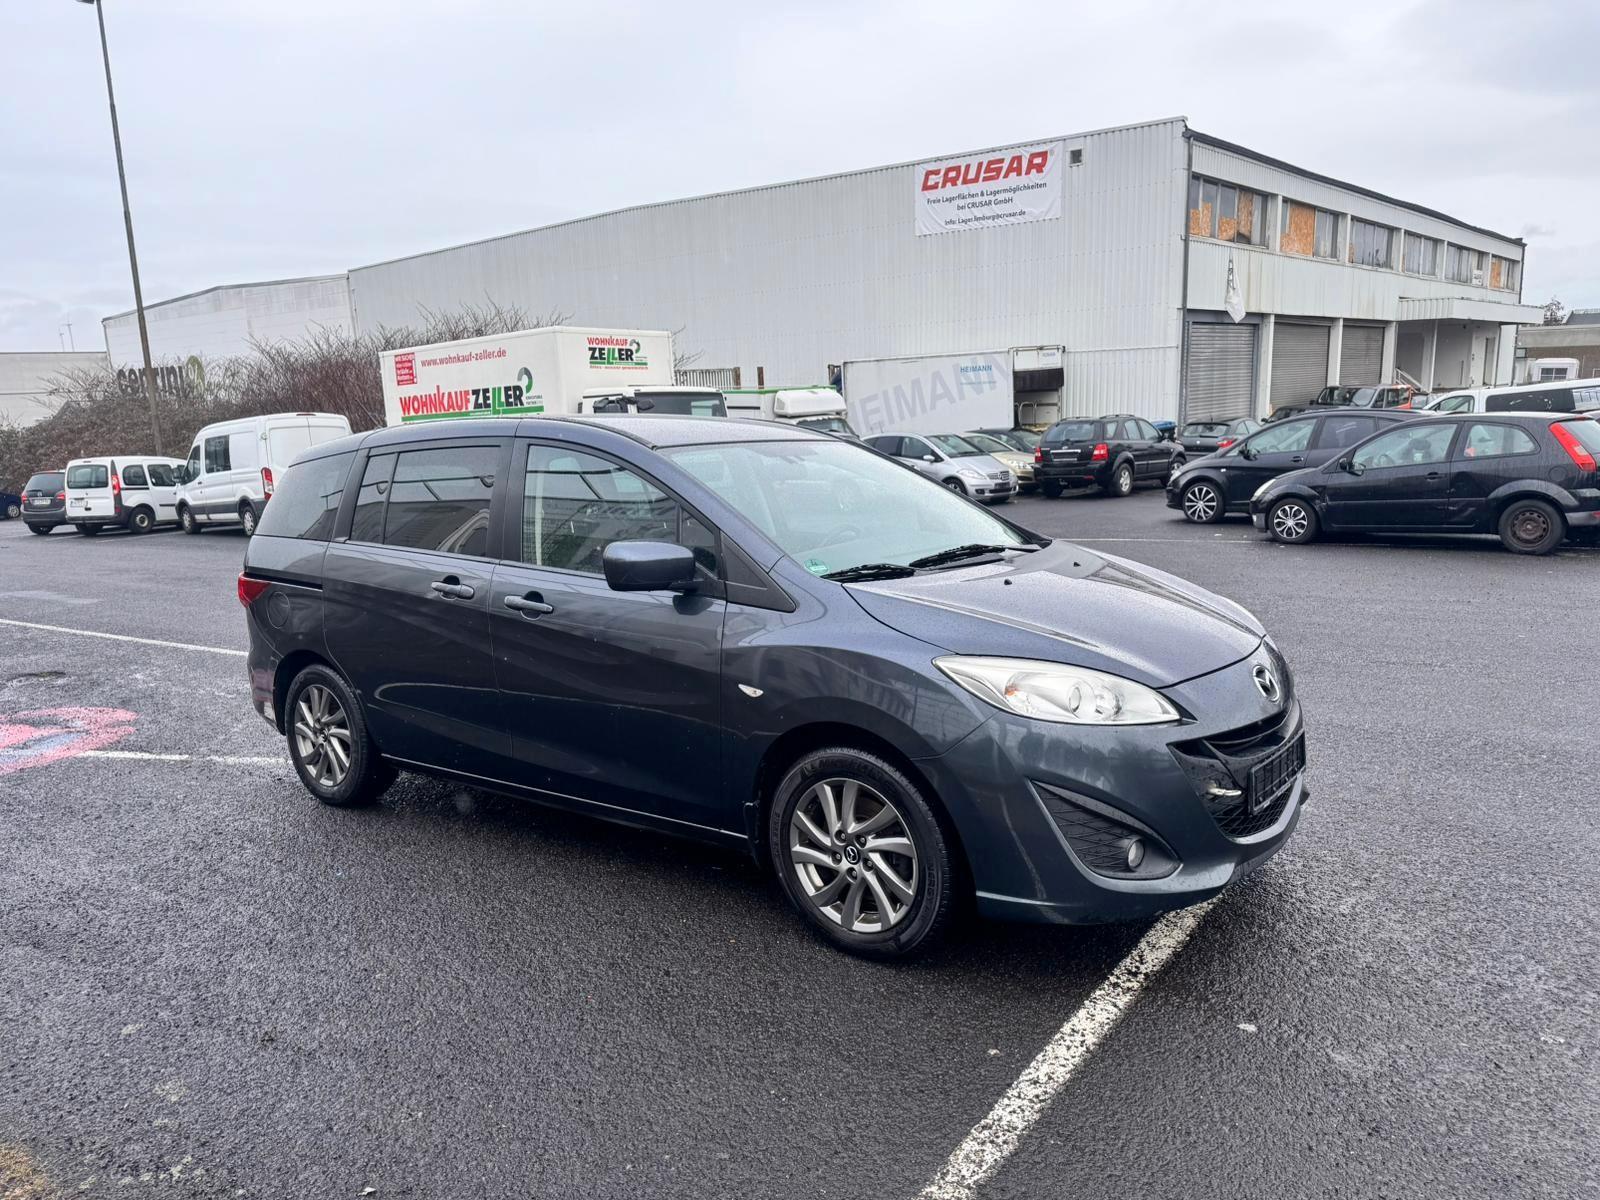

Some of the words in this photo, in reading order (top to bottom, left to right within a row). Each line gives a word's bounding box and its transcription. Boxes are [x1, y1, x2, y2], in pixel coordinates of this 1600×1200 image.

[921, 151, 1048, 191] CRUSAR
[927, 196, 941, 205] Freie
[942, 191, 979, 203] Lagerflächen
[986, 181, 1047, 196] Lagermöglichkeiten
[956, 203, 966, 211] bei
[967, 199, 992, 209] CRUSAR
[994, 197, 1013, 206] GmbH
[420, 347, 507, 367] www.wohnkauf-zeller.de
[588, 347, 634, 365] ZELLER
[960, 364, 992, 373] HEIMANN
[472, 385, 524, 416] ZELLER
